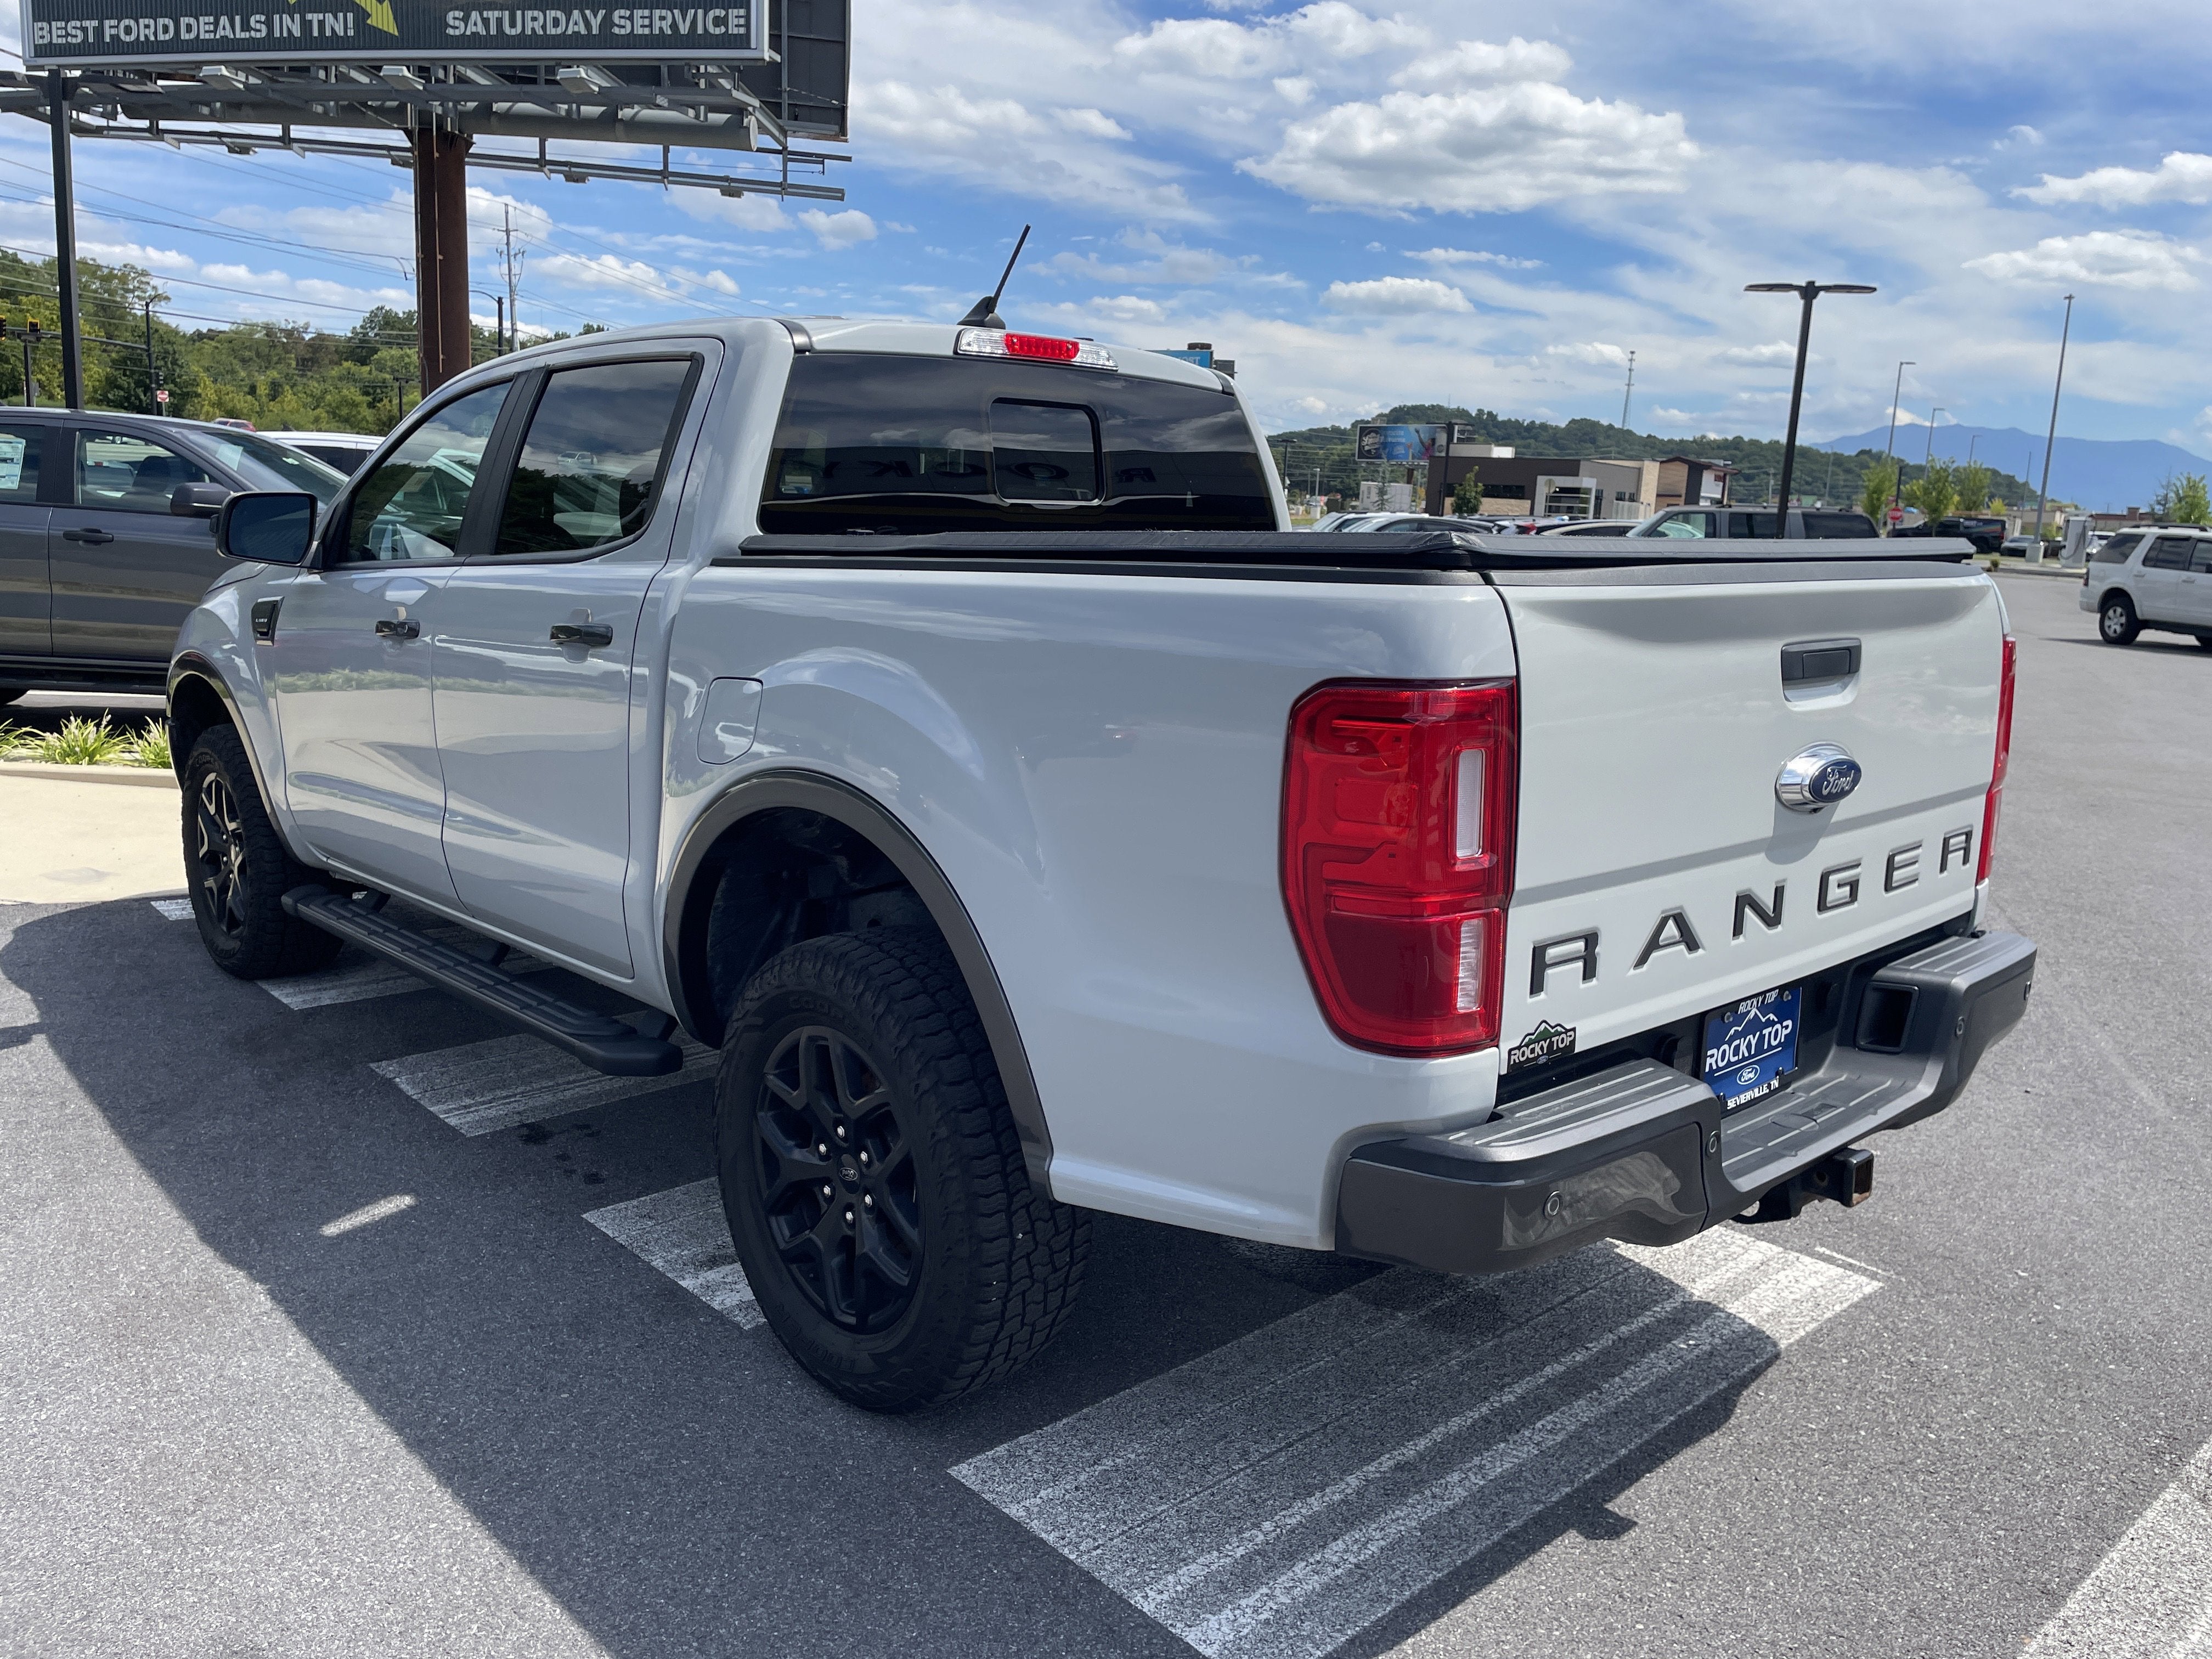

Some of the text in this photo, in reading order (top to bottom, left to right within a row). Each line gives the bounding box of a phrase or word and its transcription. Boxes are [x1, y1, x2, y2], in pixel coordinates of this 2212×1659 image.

[33, 12, 354, 44] BEST FORD DEALS IN TN!
[445, 8, 747, 36] SATURDAY SERVICE
[1822, 765, 1854, 796] Ford
[1529, 828, 1973, 998] RANGER
[1738, 989, 1779, 1014] ROCKY TOP
[1510, 1031, 1575, 1064] ROCKY TOP
[1705, 1019, 1792, 1073] ROCKY TOP
[1741, 1068, 1756, 1082] Ford
[1770, 1077, 1779, 1091] TN
